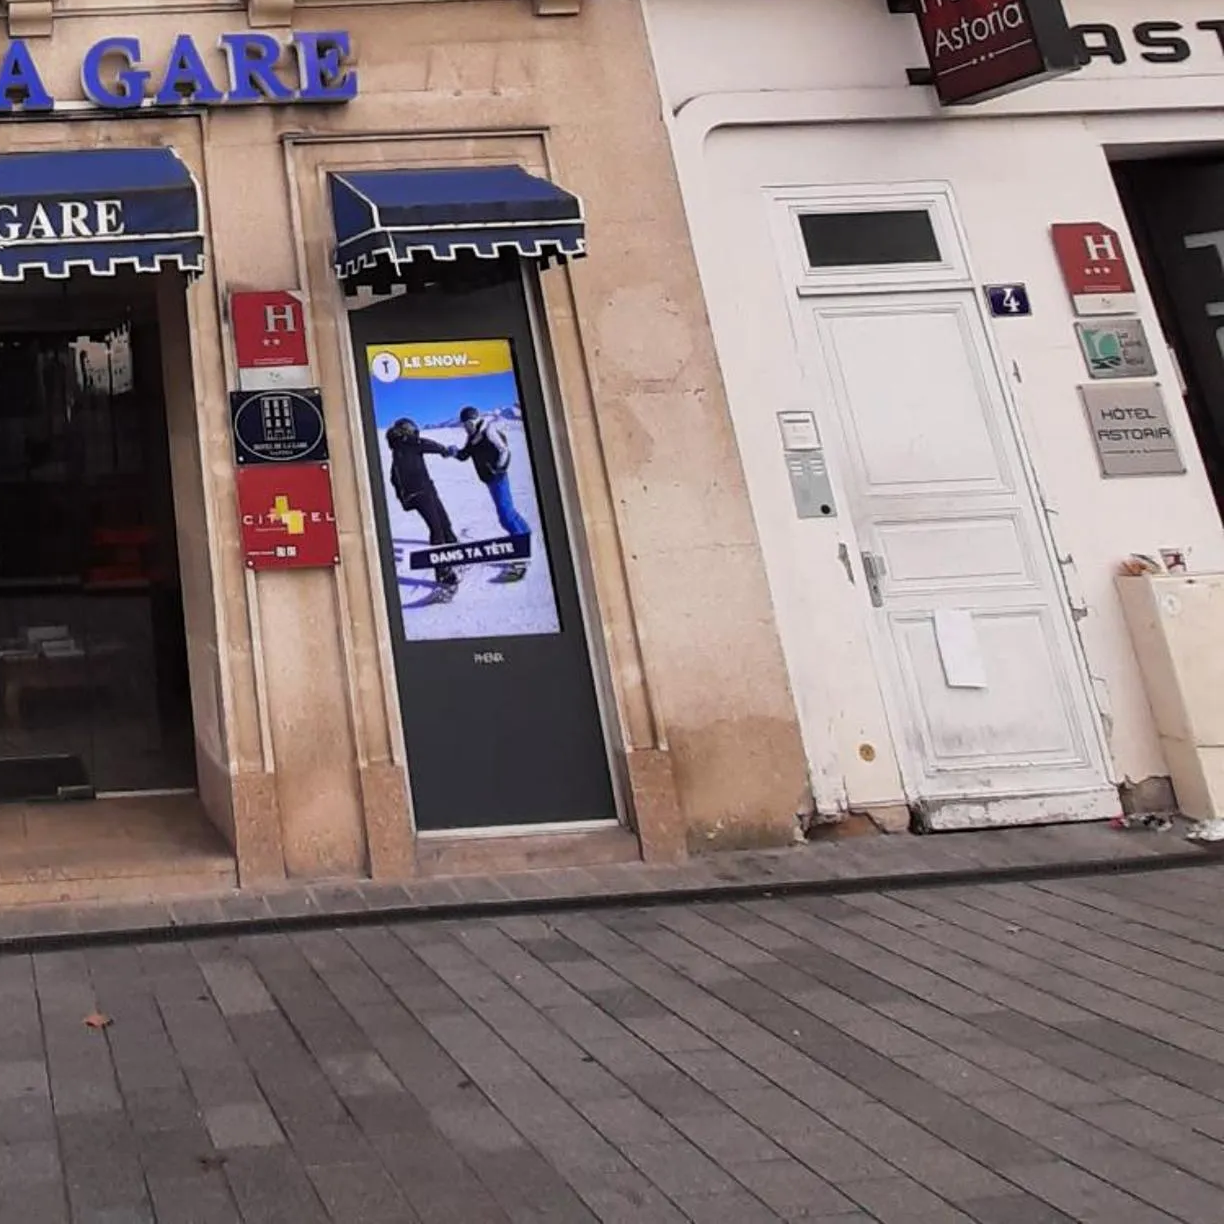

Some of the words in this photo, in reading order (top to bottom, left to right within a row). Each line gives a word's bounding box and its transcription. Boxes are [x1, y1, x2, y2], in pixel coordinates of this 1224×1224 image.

[934, 1, 1025, 57] Astoria
[80, 30, 359, 109] GARE
[1084, 234, 1121, 261] H
[1002, 287, 1021, 313] 4
[264, 303, 297, 333] H
[403, 356, 422, 369] LE
[1097, 426, 1173, 442] ASTORIA
[429, 548, 465, 565] DANS
[465, 546, 484, 559] TA
[483, 540, 515, 556] TÊTE
